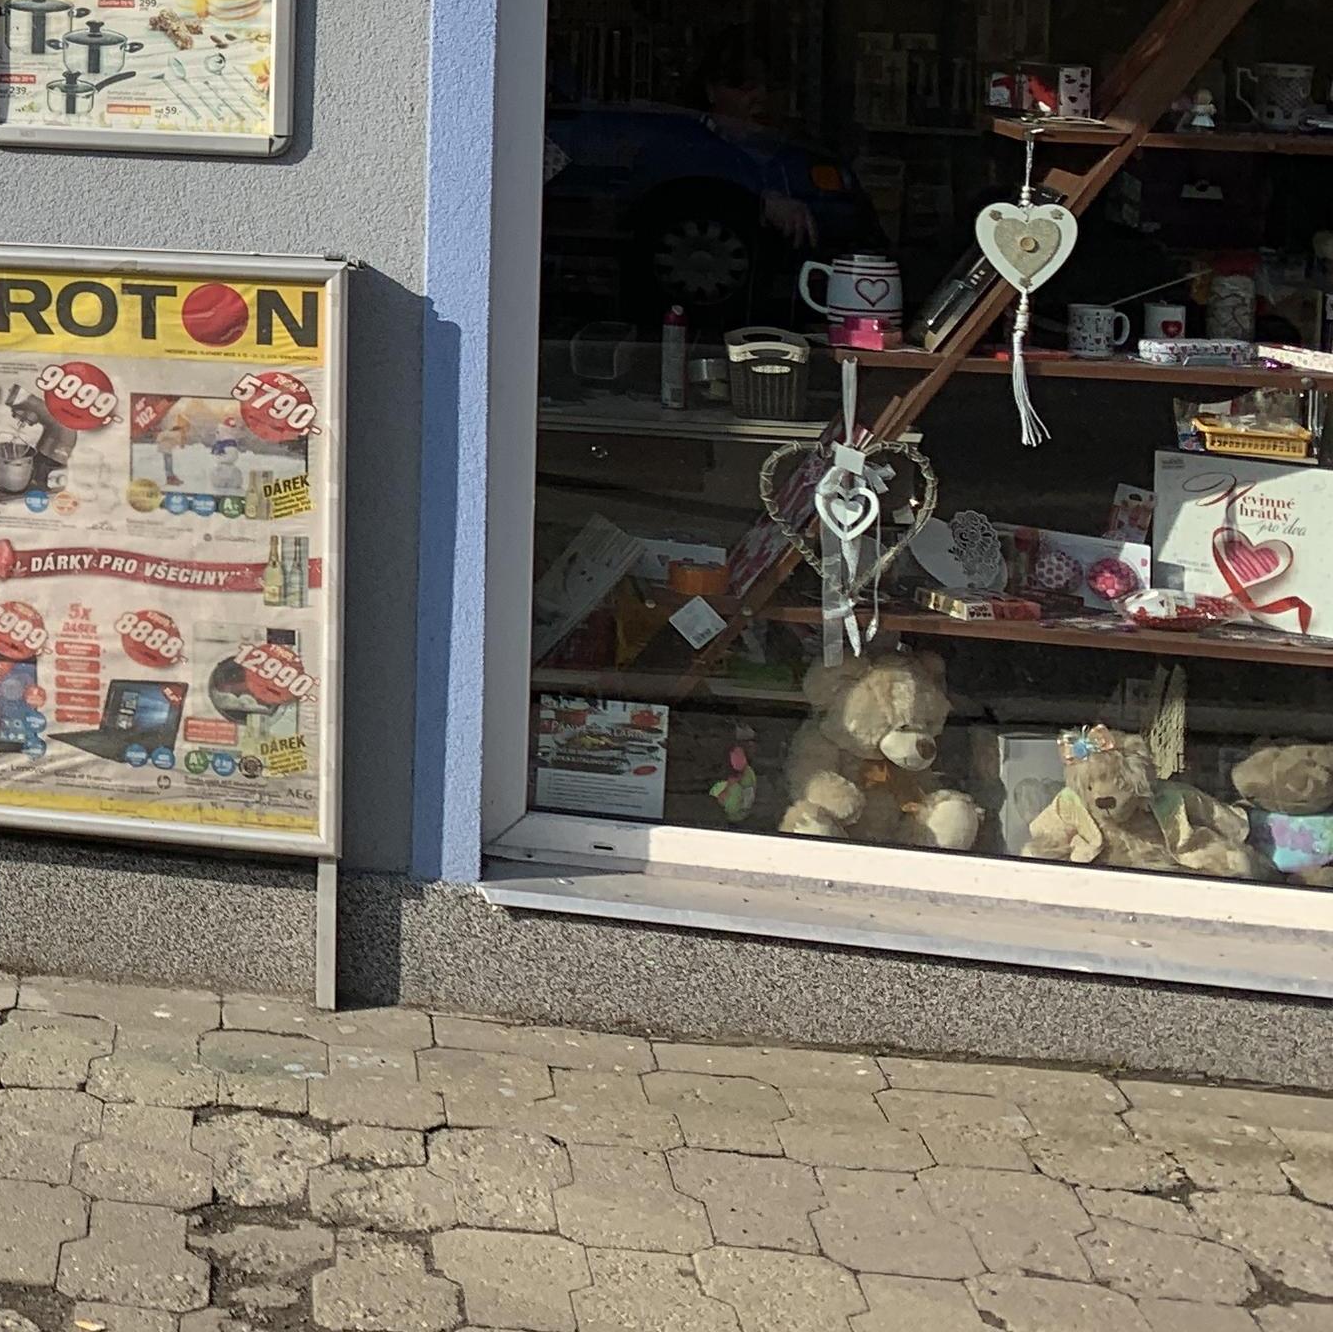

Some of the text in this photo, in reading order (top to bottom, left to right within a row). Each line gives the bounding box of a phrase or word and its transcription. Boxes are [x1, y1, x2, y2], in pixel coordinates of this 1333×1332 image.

[263, 474, 310, 498] DÁREK
[1239, 502, 1292, 521] hrátky
[31, 552, 229, 585] DÁRKY PRO VŠECHNY
[260, 735, 307, 755] DÁREK
[286, 787, 313, 800] AEG
